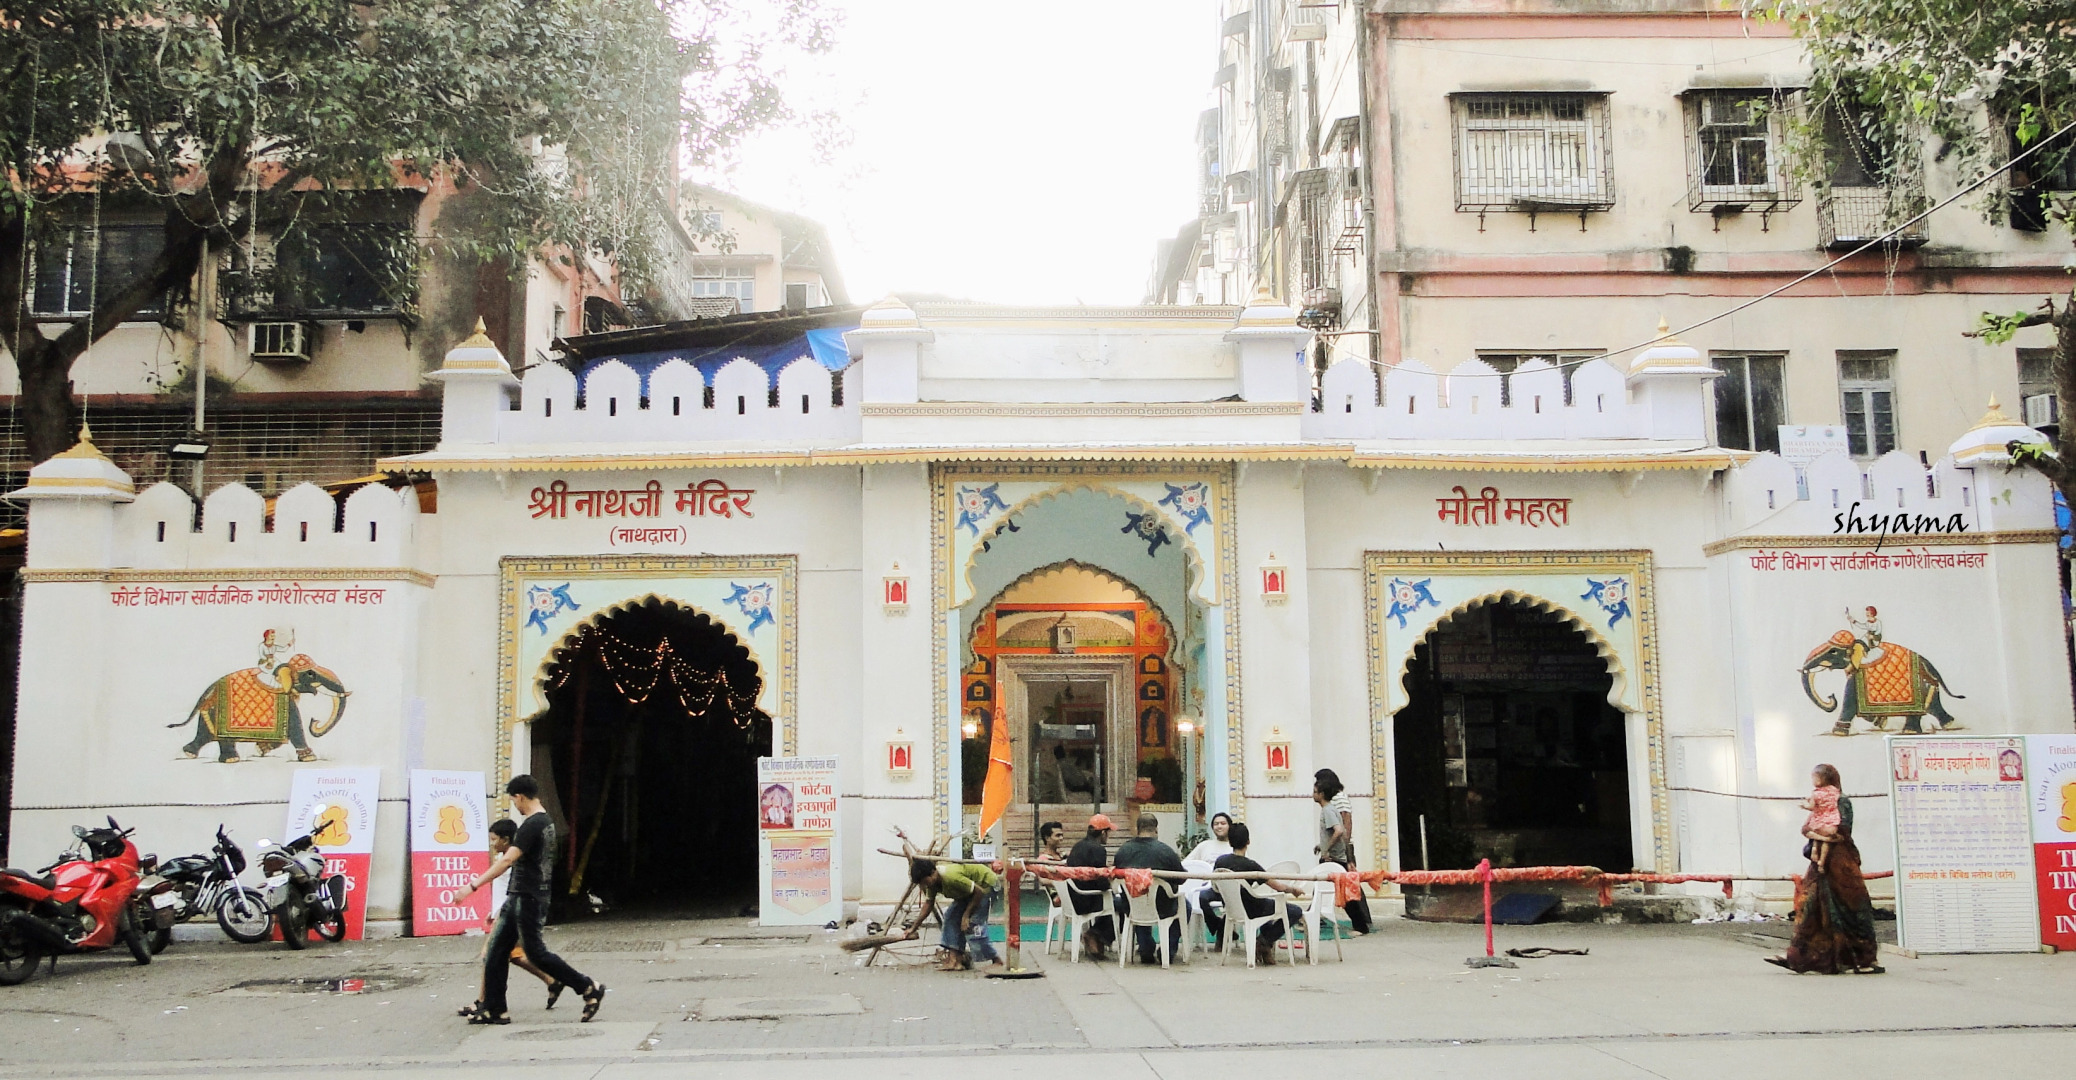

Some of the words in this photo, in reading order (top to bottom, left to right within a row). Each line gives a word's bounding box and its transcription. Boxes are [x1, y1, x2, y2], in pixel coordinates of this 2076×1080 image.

[528, 479, 663, 519] श्रीनाथजी
[674, 479, 756, 519] मंदिर
[1436, 485, 1500, 528] मोती
[1504, 498, 1573, 528] महल
[1749, 549, 1779, 571] फोर्ट
[1782, 551, 1828, 571] विभाग
[1830, 551, 1891, 571] सार्वजनिक
[1892, 547, 1954, 570] गणेशोत्सव
[1956, 550, 1988, 569] मंडल
[111, 585, 142, 606] फोर्ट
[144, 586, 189, 606] विभाग
[191, 585, 254, 606] सार्वजनिक
[258, 582, 341, 604] गणेशोत्सव
[344, 584, 386, 604] मंडल
[317, 777, 346, 785] Finalist
[432, 777, 457, 785] Finalist
[459, 777, 466, 785] in
[313, 789, 349, 801] Moorti
[430, 789, 461, 801] Moorti
[803, 815, 831, 828] गणेश
[432, 856, 471, 871] THE
[427, 905, 480, 922] INDIA
